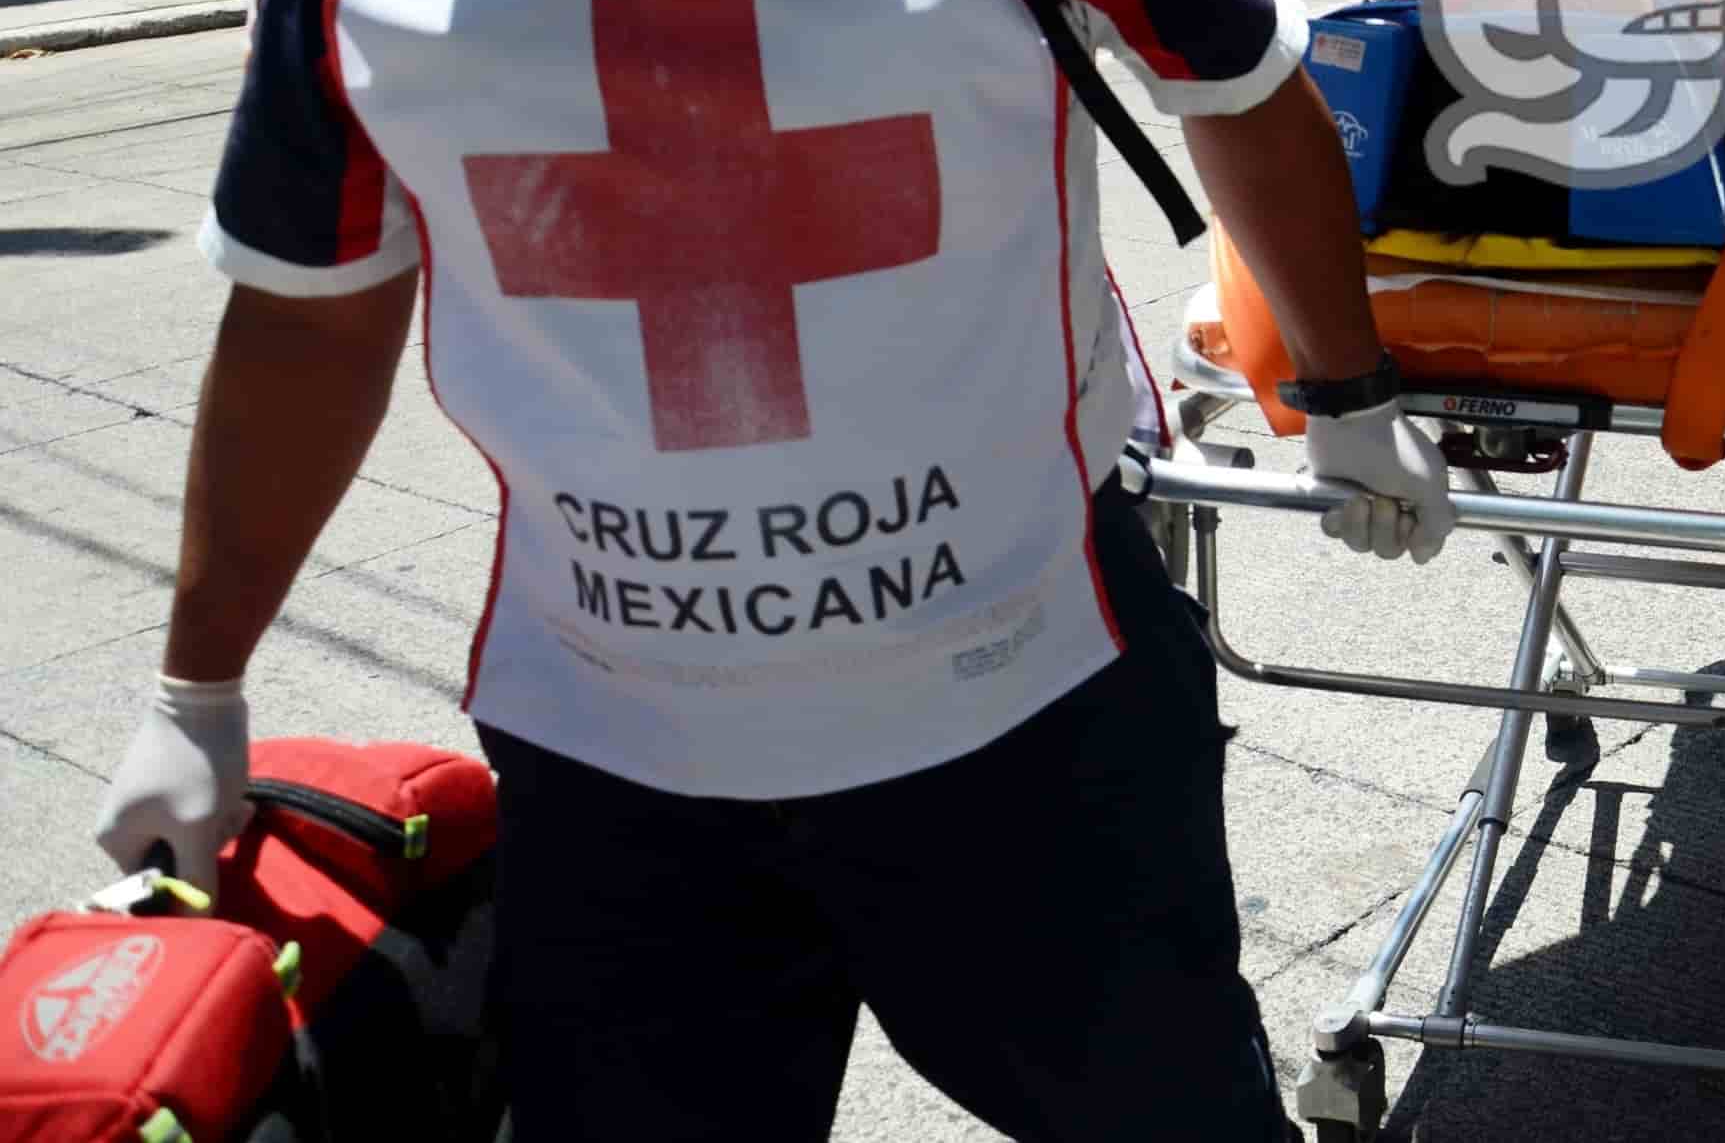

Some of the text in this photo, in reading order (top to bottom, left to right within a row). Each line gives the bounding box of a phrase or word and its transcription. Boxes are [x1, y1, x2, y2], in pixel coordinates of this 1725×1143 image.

[1459, 397, 1517, 417] FERNO
[554, 464, 962, 563] CRUZ ROJA
[572, 541, 966, 636] MEXICANA
